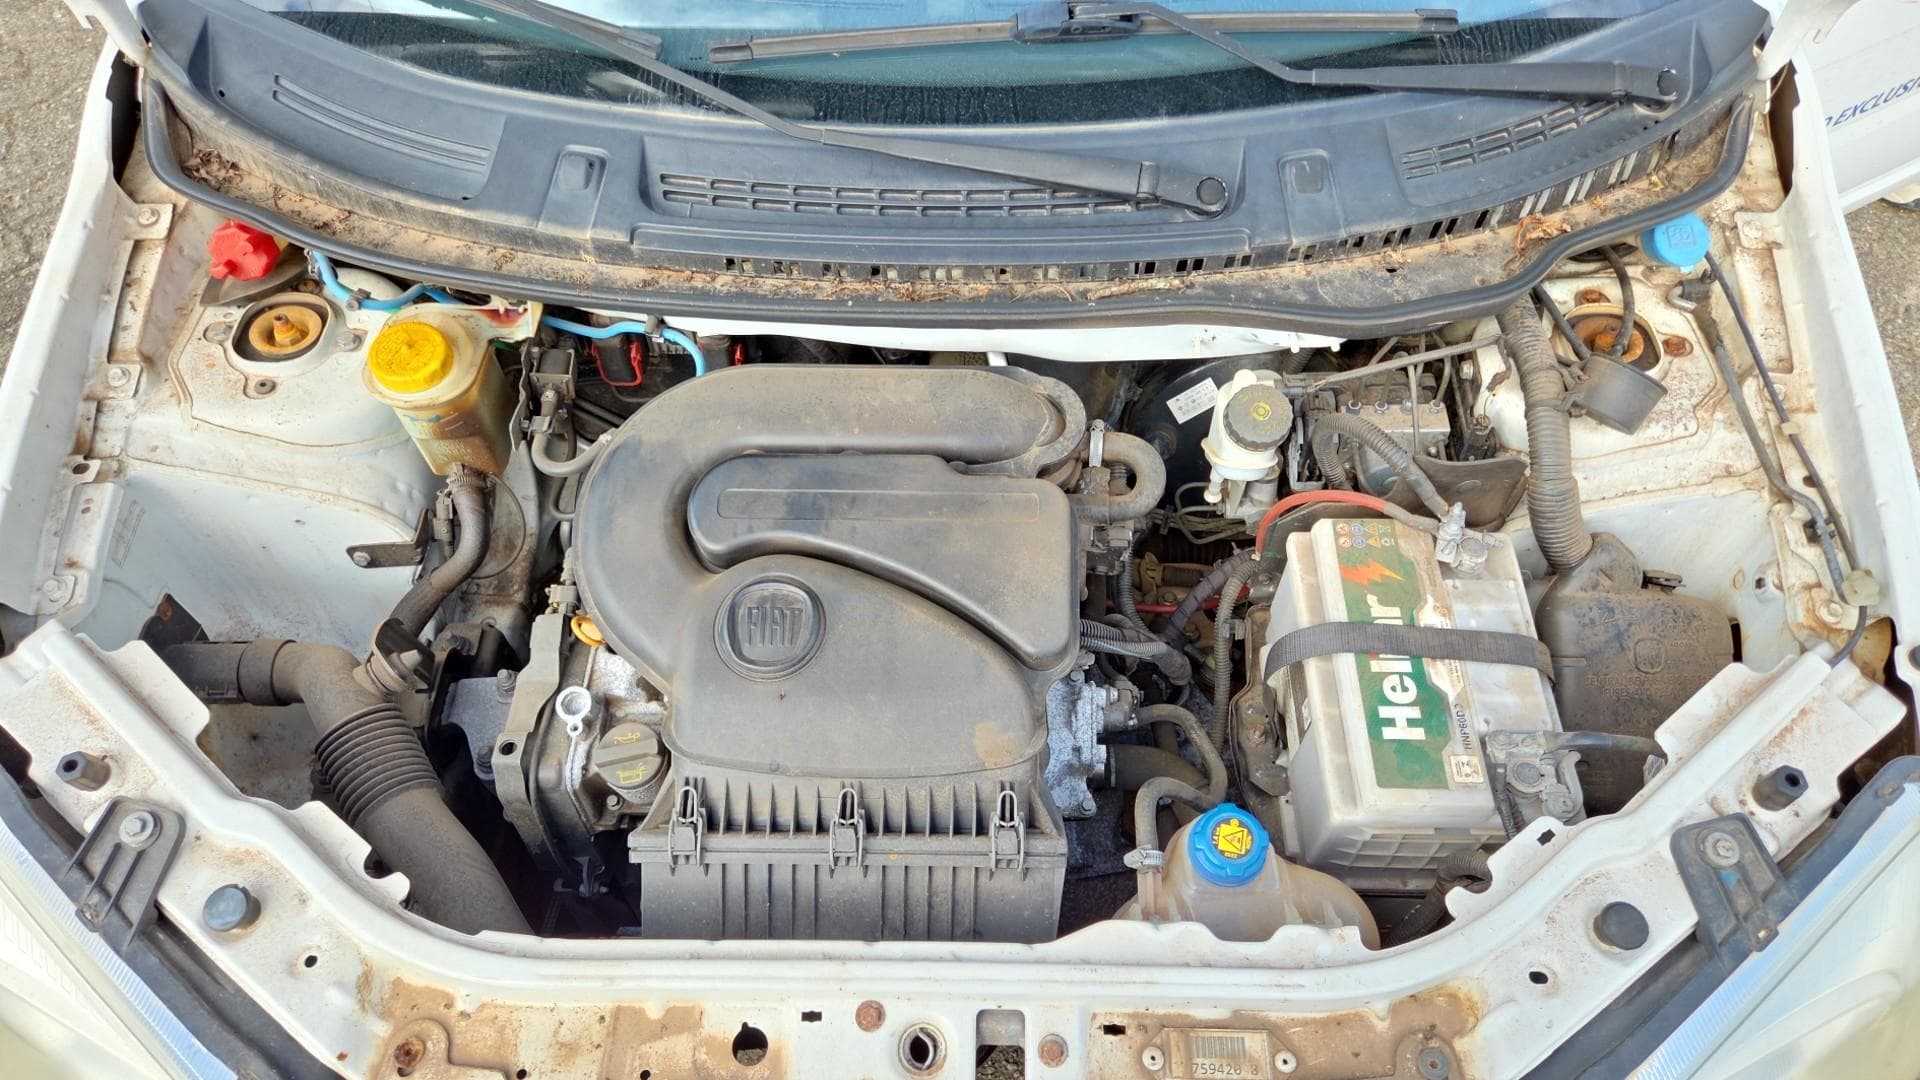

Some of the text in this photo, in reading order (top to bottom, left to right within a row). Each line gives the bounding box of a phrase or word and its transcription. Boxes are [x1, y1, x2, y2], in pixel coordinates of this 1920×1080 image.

[1832, 77, 1920, 127] EXCLUSI
[746, 606, 803, 646] FIAT
[1366, 593, 1426, 740] Helr
